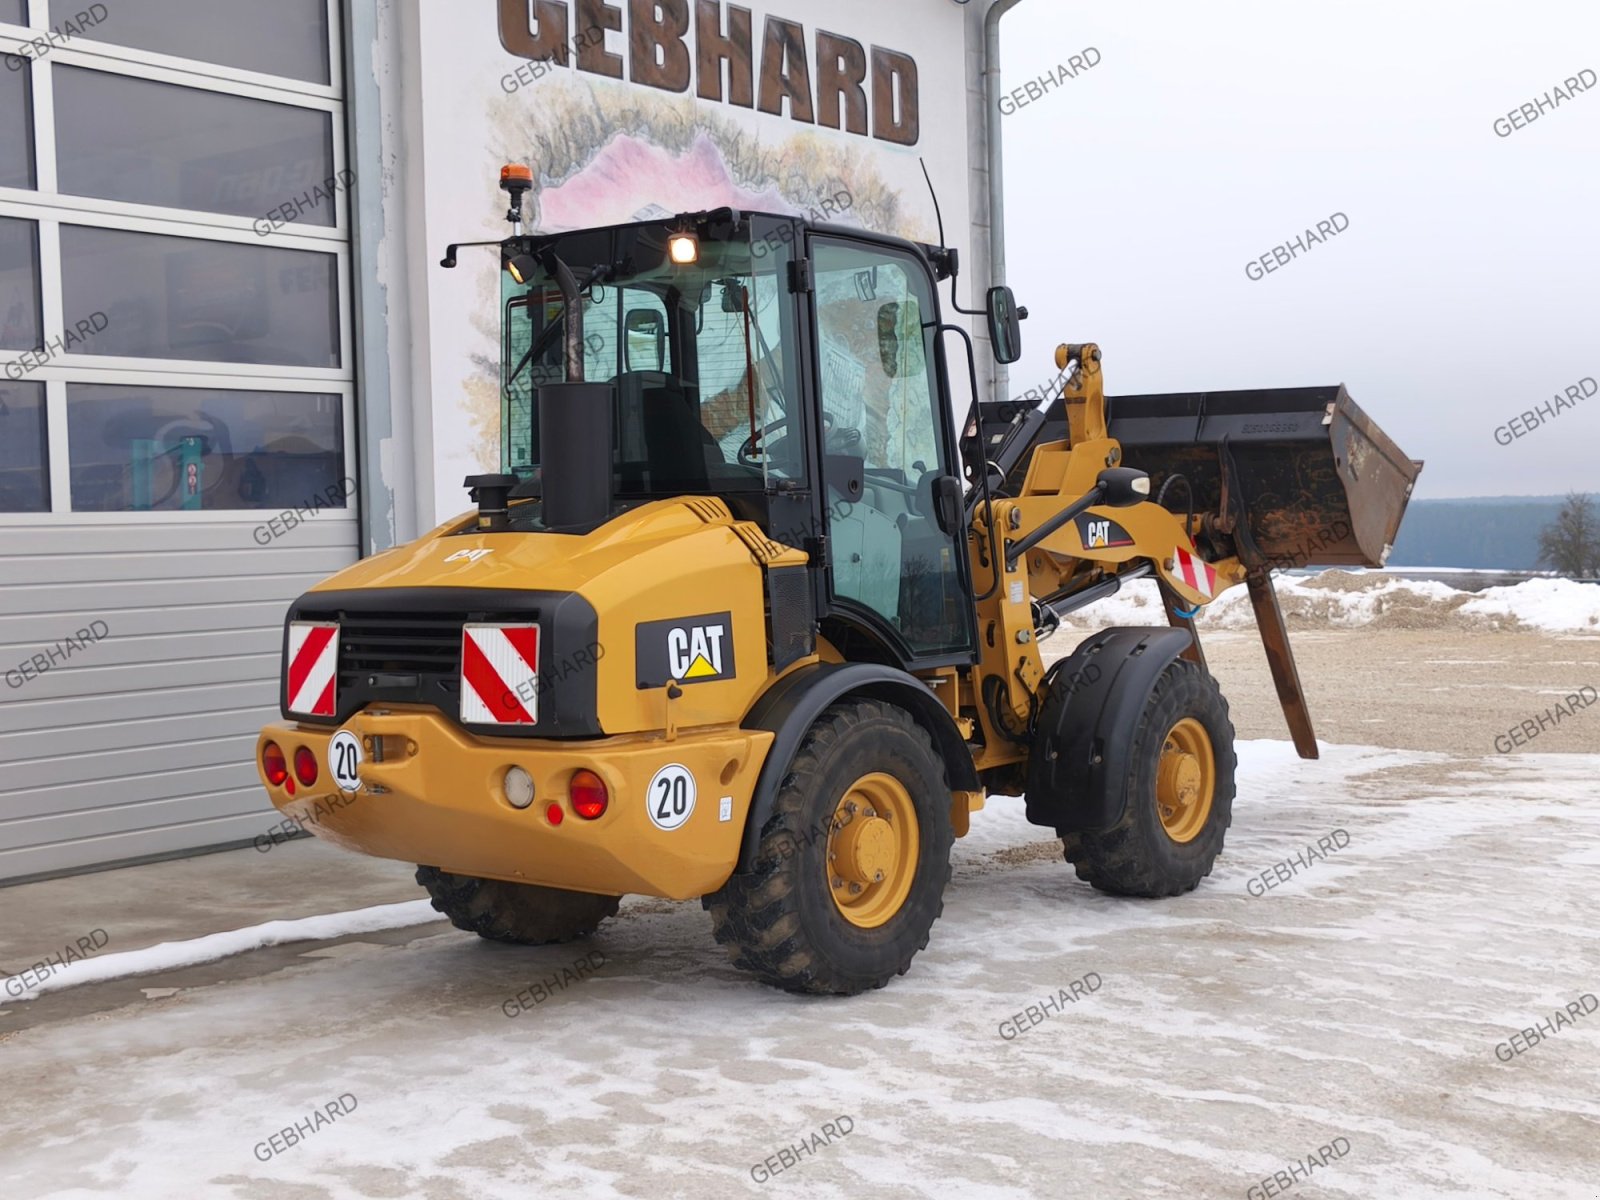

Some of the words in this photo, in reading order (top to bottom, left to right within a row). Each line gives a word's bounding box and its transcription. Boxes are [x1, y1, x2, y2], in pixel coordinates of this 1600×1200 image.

[497, 0, 919, 147] GEBHARD
[443, 548, 496, 562] CAT
[1088, 521, 1110, 548] CAT
[667, 624, 724, 679] CAT
[335, 741, 358, 781] 20
[657, 775, 687, 819] 20
